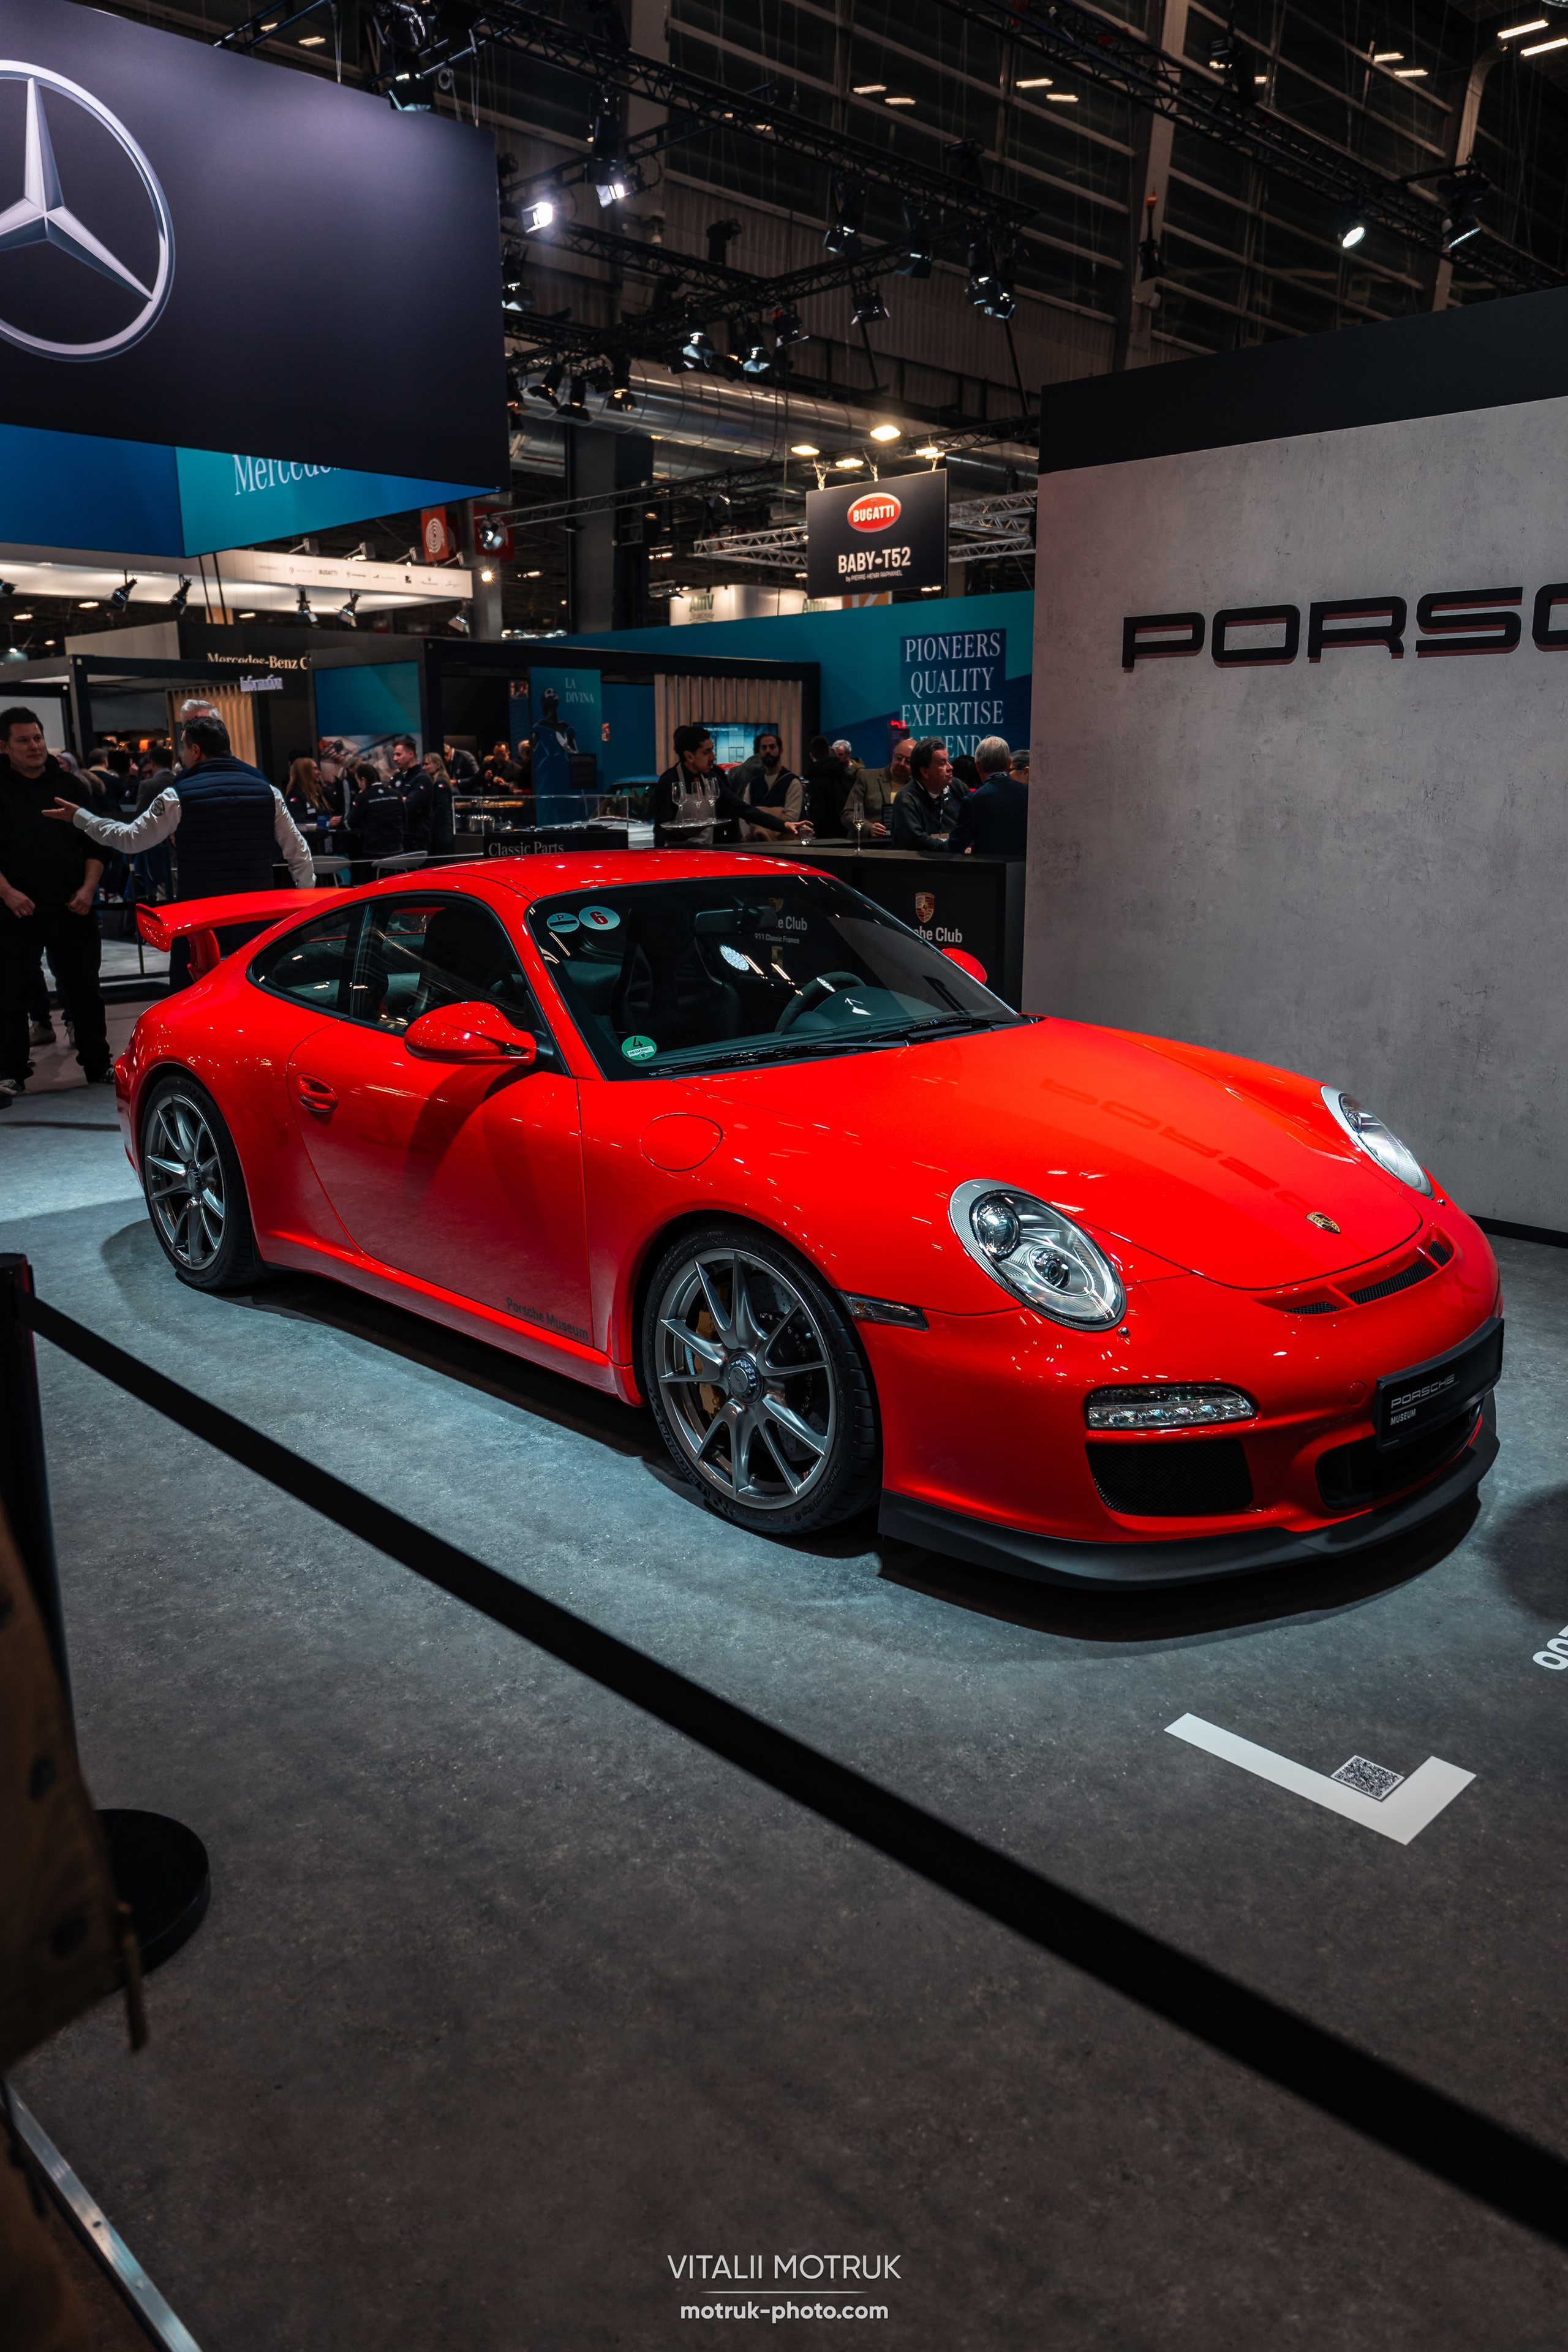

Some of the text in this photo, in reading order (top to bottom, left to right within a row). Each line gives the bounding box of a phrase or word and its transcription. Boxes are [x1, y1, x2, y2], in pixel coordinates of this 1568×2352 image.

[853, 505, 895, 522] BUGATTI
[838, 546, 911, 574] BABY-T52
[851, 572, 880, 581] PIERRE-HENRI
[880, 570, 903, 579] RAPHANEL
[905, 632, 1001, 662] PIONEERS
[565, 677, 576, 688] LA
[911, 667, 995, 698] QUALITY
[565, 692, 595, 704] DIVINA
[901, 701, 1004, 727] EXPERTISE
[488, 841, 564, 857] Classic Parts
[589, 911, 609, 925] 6
[785, 916, 807, 930] Club
[765, 933, 782, 942] Classic
[783, 935, 799, 944] France
[935, 927, 962, 943] Club
[633, 1036, 643, 1047] 4
[506, 1296, 589, 1340] Porsche Museum
[1391, 1374, 1455, 1408] PORSCHE
[1390, 1408, 1416, 1426] MUSEUM
[660, 1420, 699, 1487] MICHELIN
